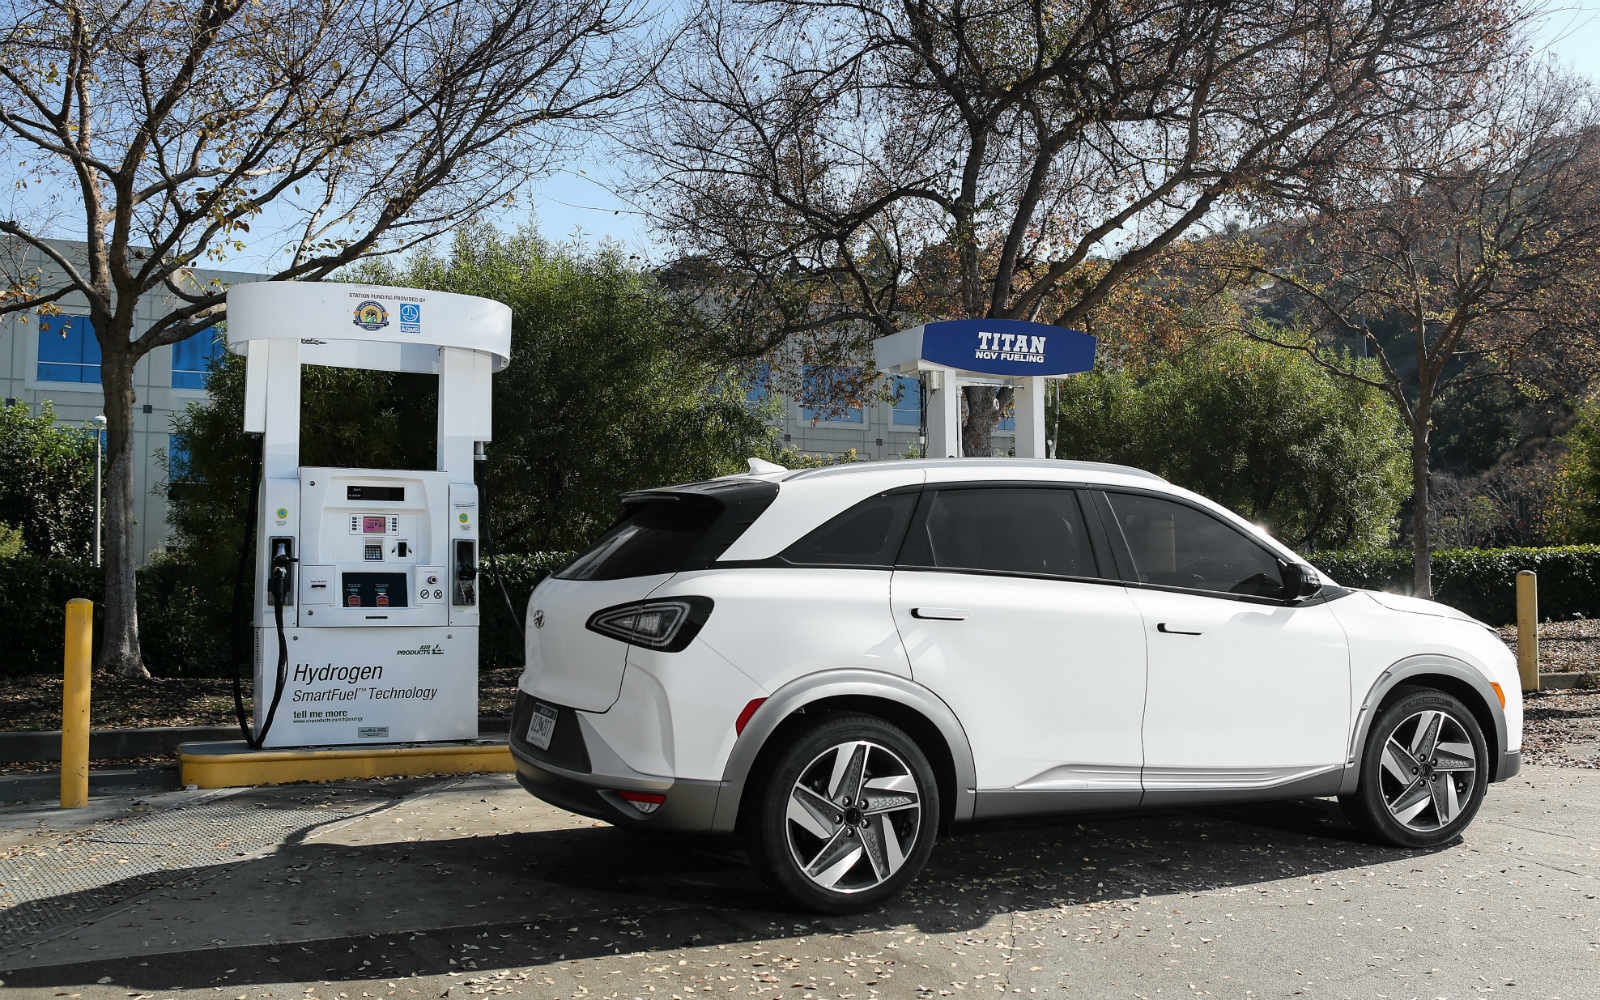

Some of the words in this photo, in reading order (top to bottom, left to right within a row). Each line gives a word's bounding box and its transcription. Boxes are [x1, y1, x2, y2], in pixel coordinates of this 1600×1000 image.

[394, 295, 418, 303] PROVIDED
[978, 331, 1046, 354] TITAN
[975, 351, 999, 360] NGV
[1000, 353, 1045, 363] FUELING
[293, 663, 383, 686] Hydrogen
[368, 686, 438, 701] Technology
[293, 710, 307, 719] tell
[325, 710, 348, 718] more
